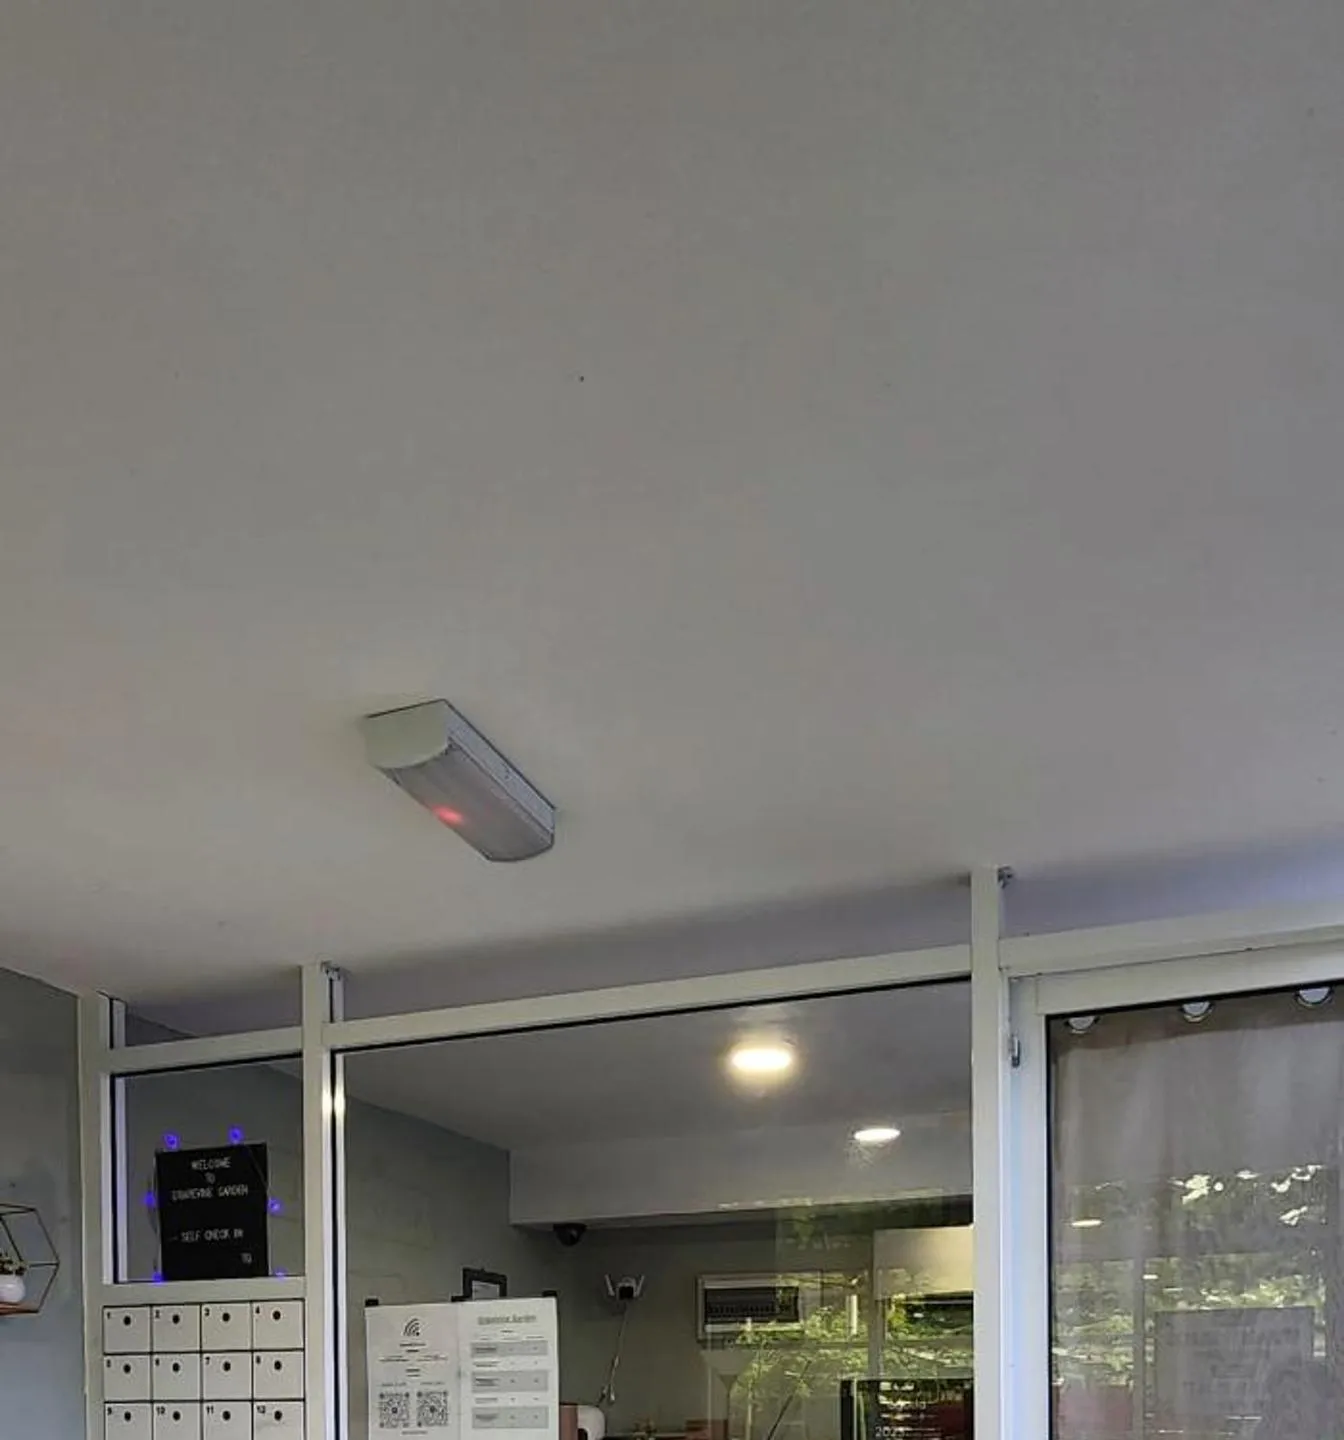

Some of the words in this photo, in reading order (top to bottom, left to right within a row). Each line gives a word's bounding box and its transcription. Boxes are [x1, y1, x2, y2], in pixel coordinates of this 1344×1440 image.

[191, 1157, 231, 1170] WELCOME
[181, 1230, 200, 1243] SELF
[204, 1228, 230, 1241] CHECK
[155, 1405, 166, 1416] 10
[205, 1405, 215, 1415] 11
